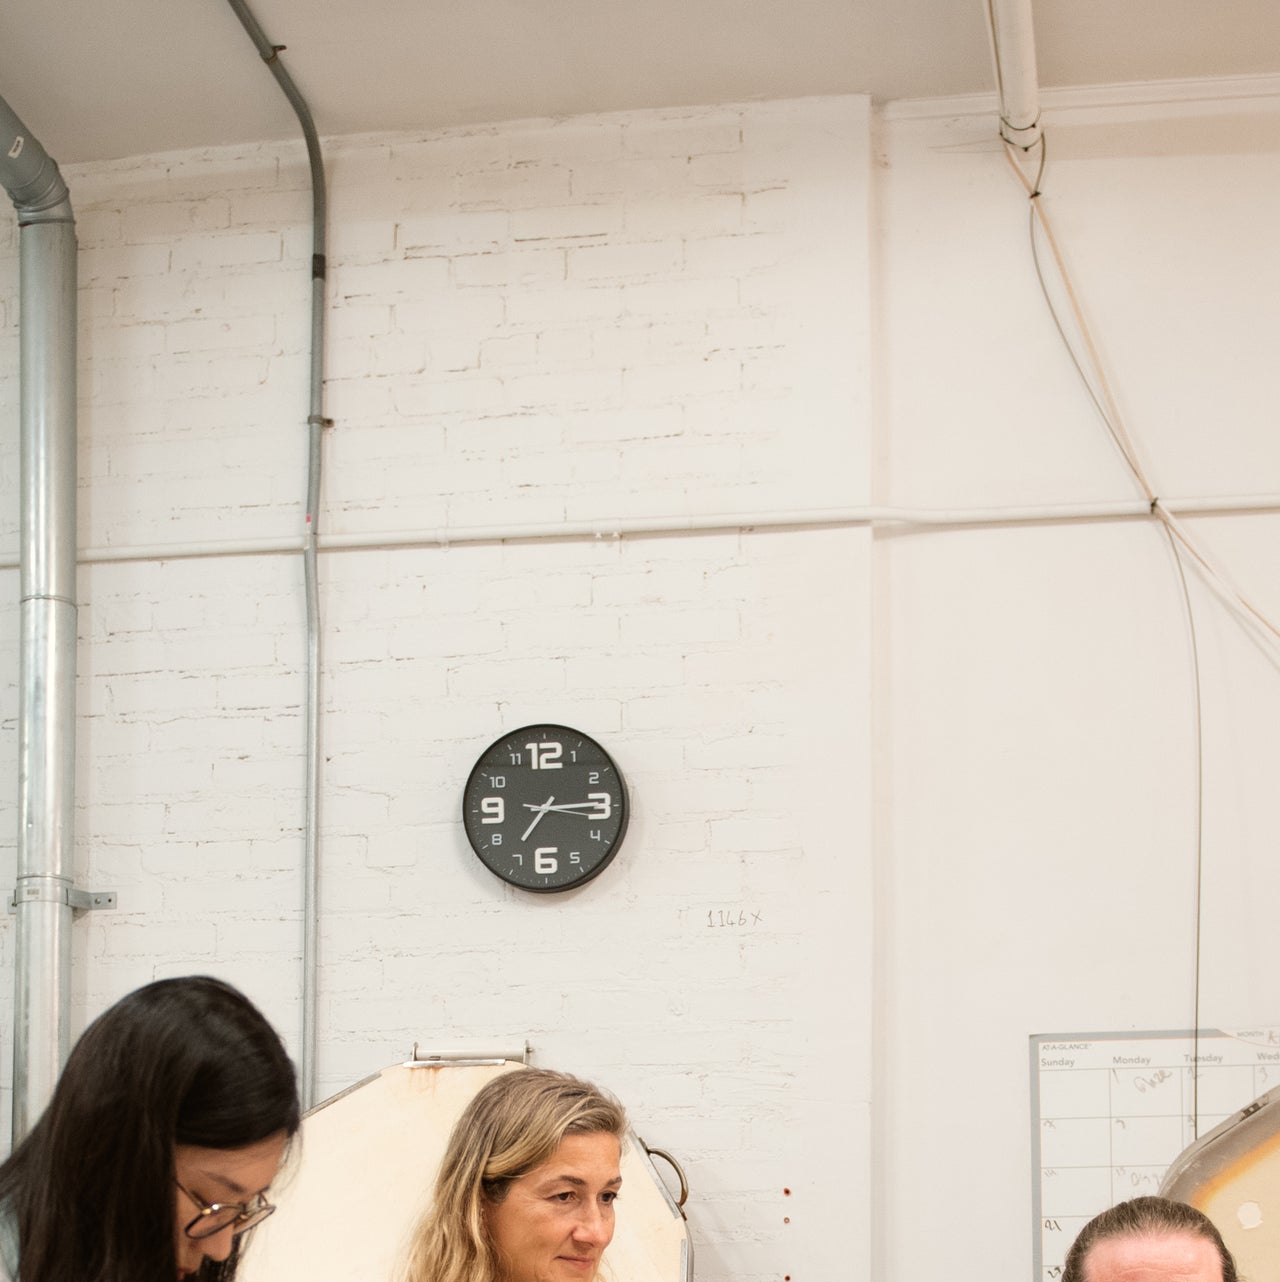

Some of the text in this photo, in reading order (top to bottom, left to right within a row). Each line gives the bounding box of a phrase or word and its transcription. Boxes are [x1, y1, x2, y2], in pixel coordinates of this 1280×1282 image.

[509, 753, 521, 765] 11
[525, 742, 563, 770] 12
[570, 751, 577, 763] 1
[489, 776, 506, 788] 10
[588, 772, 599, 784] 2
[481, 797, 504, 824] 9
[587, 793, 611, 820] 3
[491, 833, 502, 845] 8
[590, 830, 600, 842] 4
[512, 854, 523, 866] 7
[534, 847, 558, 874] 6
[570, 852, 580, 864] 5
[1041, 1058, 1075, 1068] Sunday
[1112, 1056, 1151, 1066] Monday
